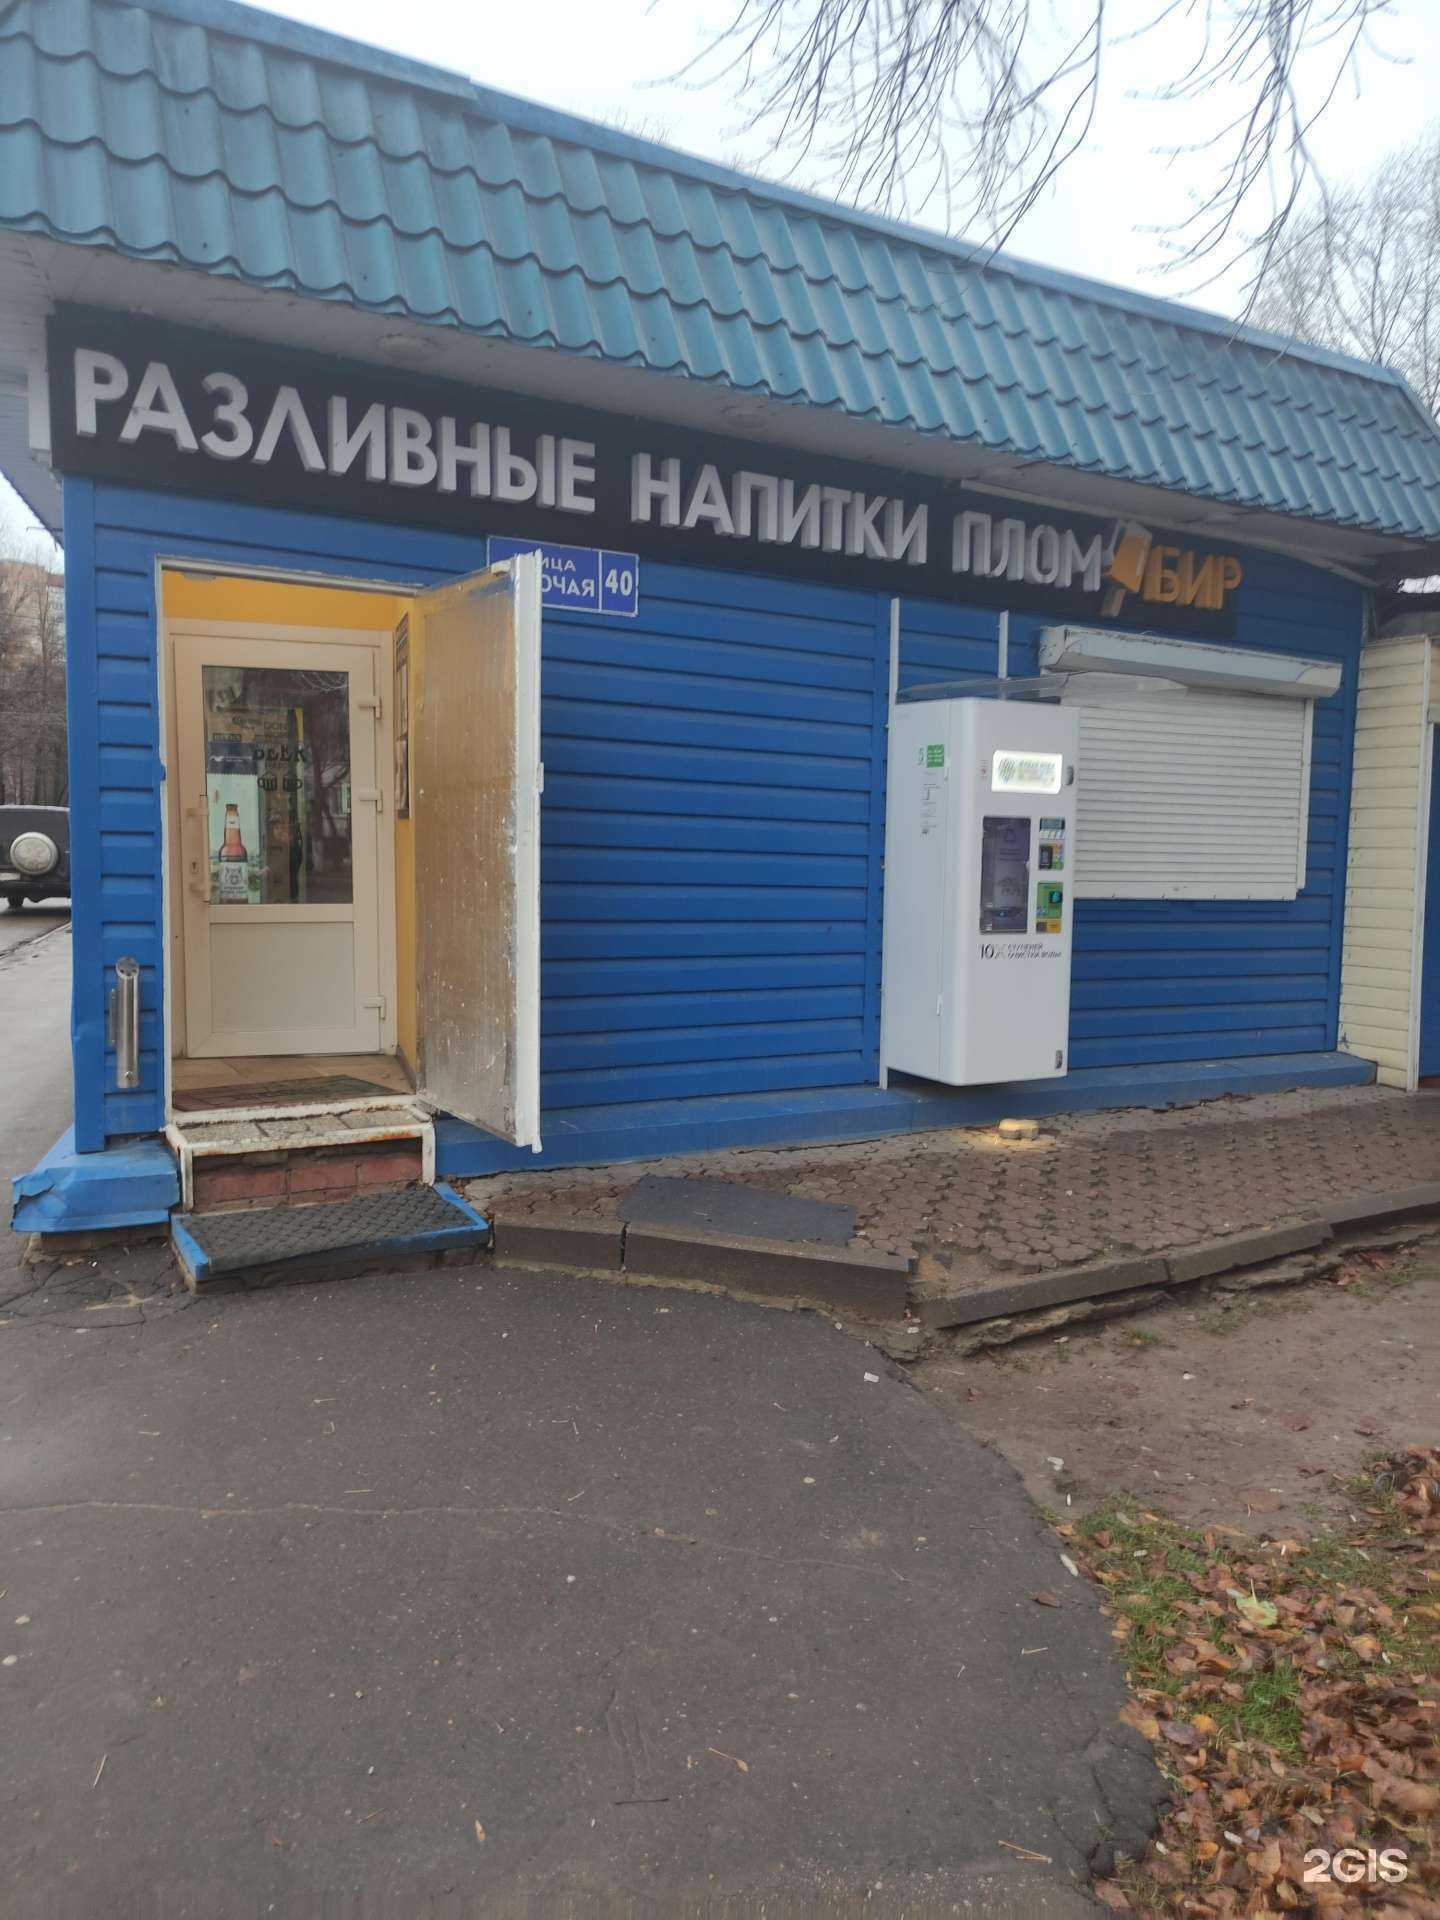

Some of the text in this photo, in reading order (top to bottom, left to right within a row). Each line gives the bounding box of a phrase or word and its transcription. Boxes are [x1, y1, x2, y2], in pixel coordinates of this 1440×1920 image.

[74, 347, 597, 514] РАЗЛИВНЫЕ
[630, 452, 929, 566] НАПИТКИ
[541, 556, 577, 572] ИЦА
[541, 574, 595, 597] ОЧАЯ
[605, 568, 633, 596] 40
